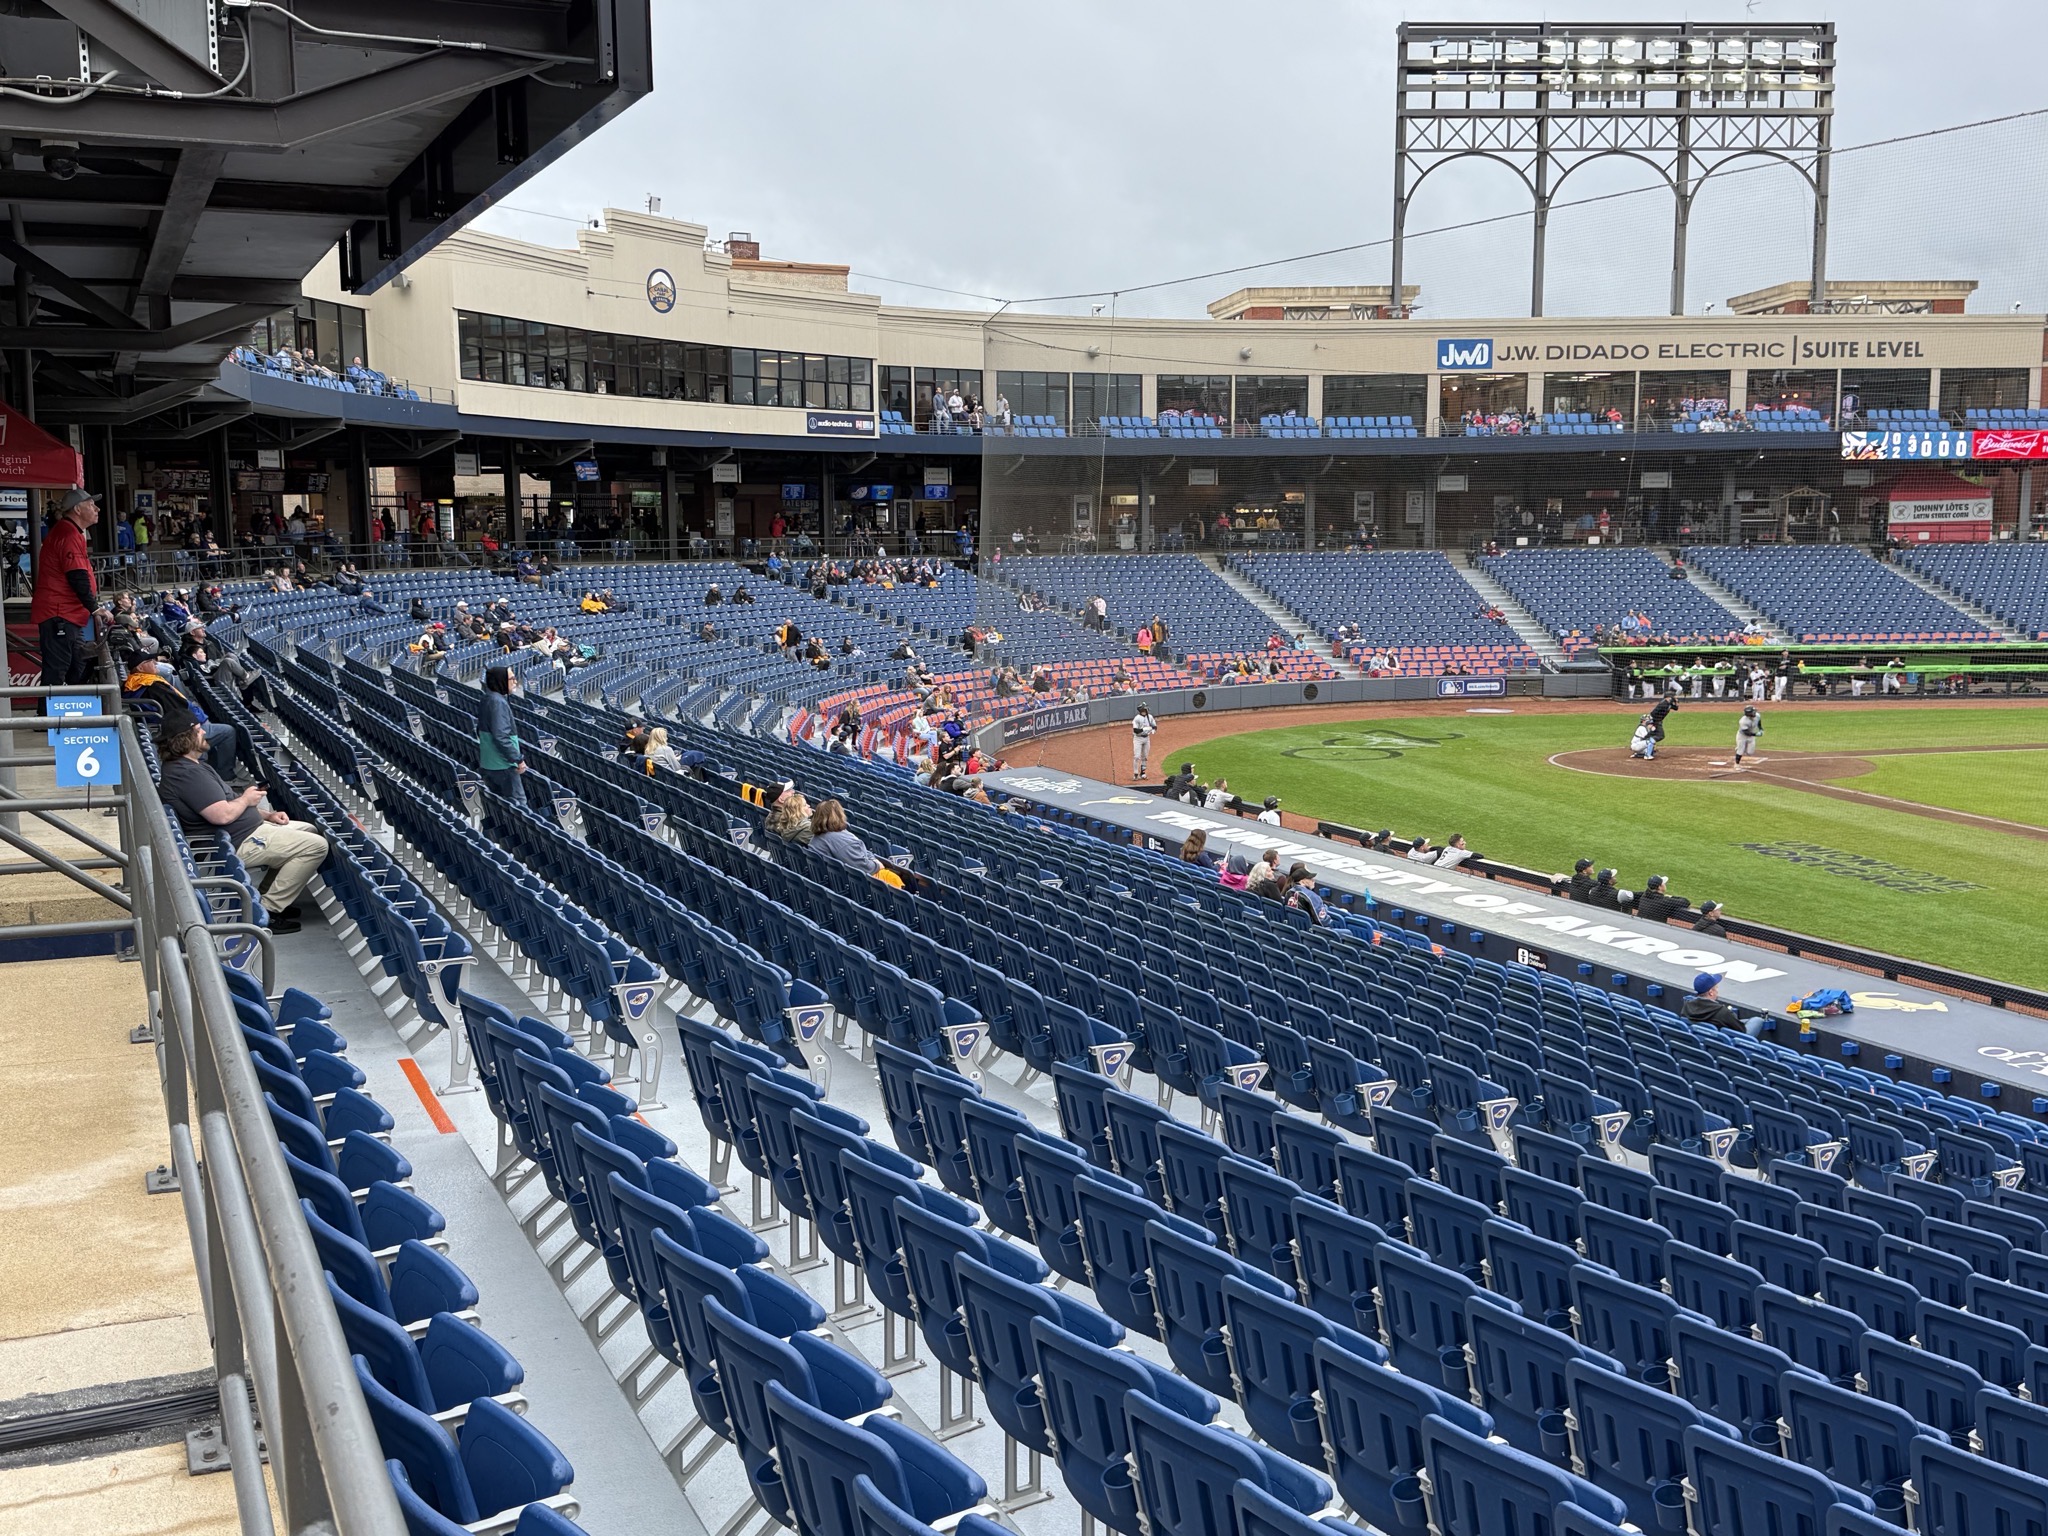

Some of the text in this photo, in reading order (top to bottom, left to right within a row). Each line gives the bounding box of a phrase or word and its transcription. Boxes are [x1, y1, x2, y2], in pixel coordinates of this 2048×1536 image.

[1497, 341, 1924, 361] J.W. DIDADO ELECTRIC SUITE LEVEL
[1907, 439, 1917, 453] 3
[1921, 440, 1967, 457] 0 0 0
[1976, 438, 2038, 450] Budweiser
[1892, 446, 1901, 458] 2
[1913, 504, 1944, 513] JOHNNY
[54, 702, 92, 710] SECTION
[1036, 707, 1087, 730] CANAL PARK
[64, 736, 109, 745] SECTION
[76, 746, 100, 778] 6
[1145, 811, 1789, 983] THE UNIVERSITY OF AKRON
